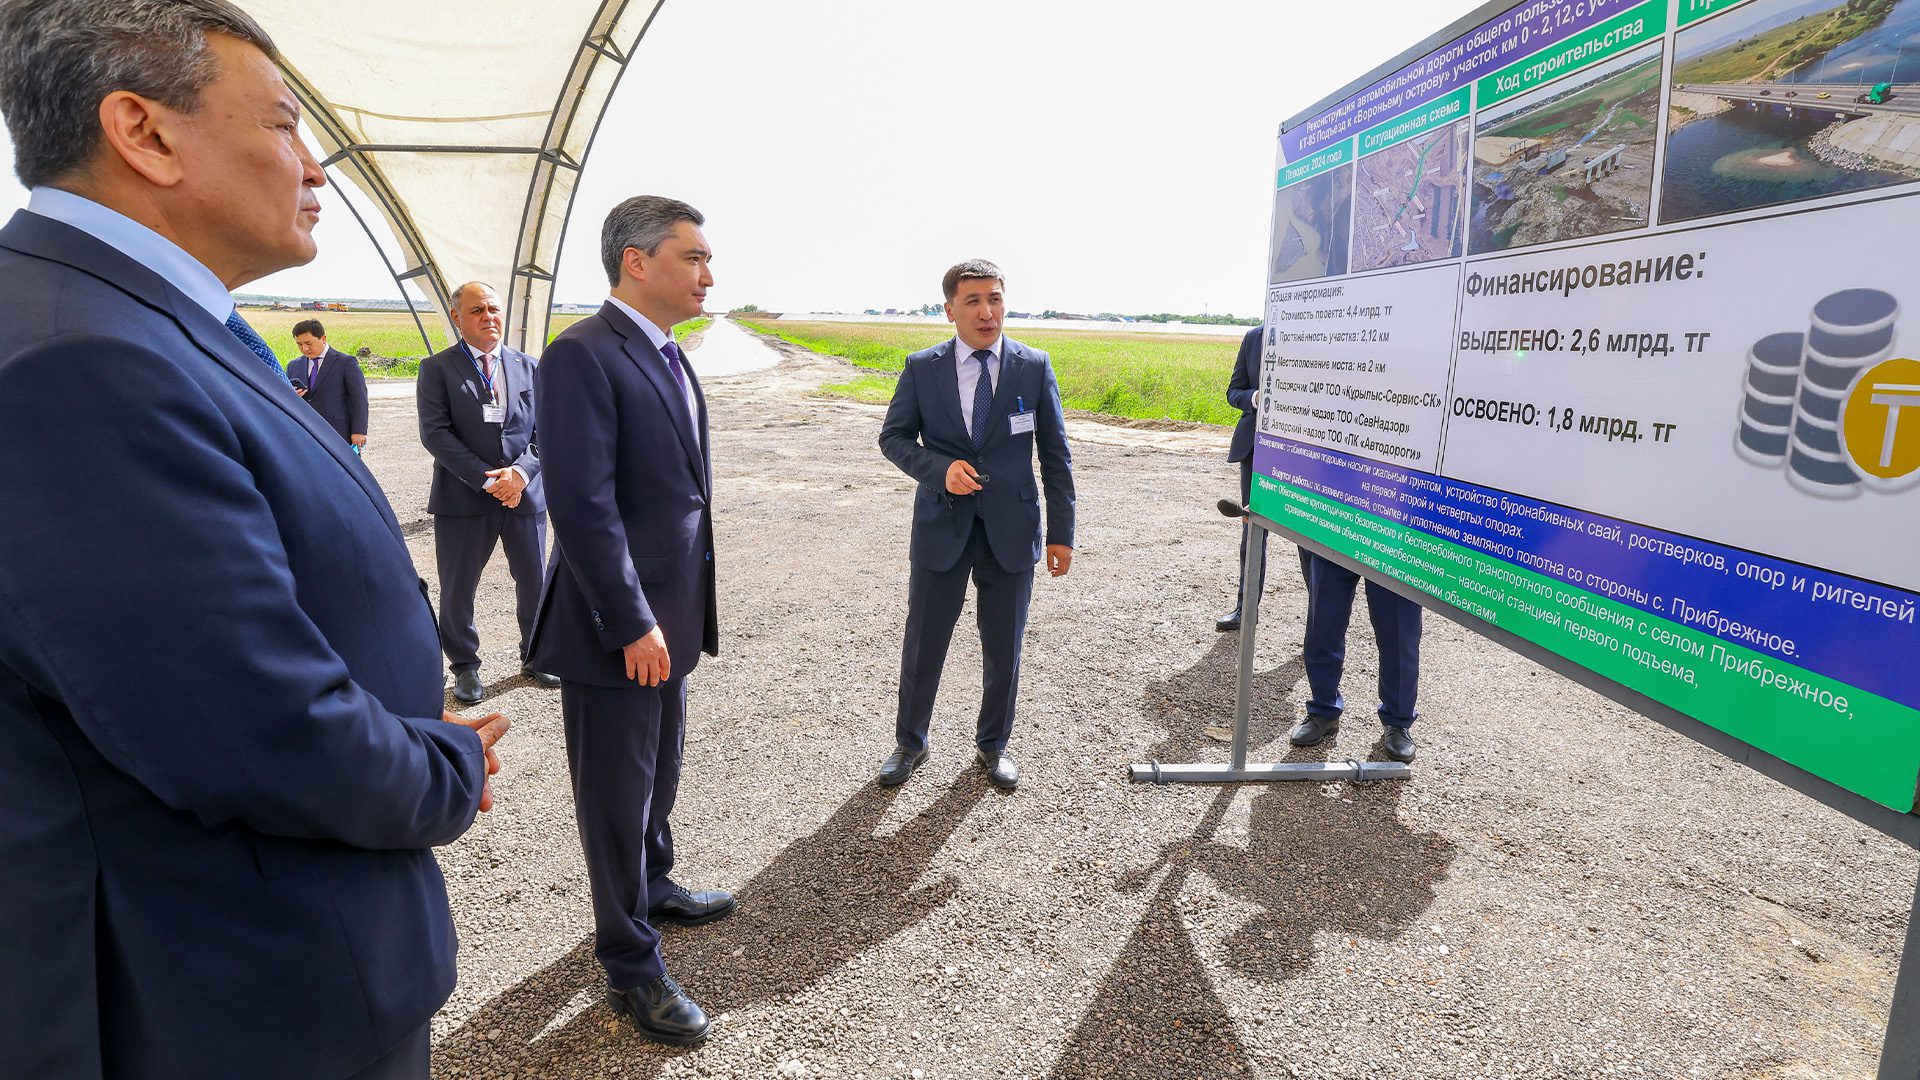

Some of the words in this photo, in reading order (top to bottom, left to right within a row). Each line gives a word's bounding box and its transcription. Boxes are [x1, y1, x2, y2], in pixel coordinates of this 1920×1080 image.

[1306, 101, 1356, 133] Реконструкция
[1357, 66, 1424, 108] автомобильной
[1426, 42, 1463, 74] дороги
[1467, 18, 1511, 51] общего
[1495, 75, 1520, 95] Ход
[1524, 18, 1643, 82] строительства
[1317, 121, 1346, 144] Подъезд
[1354, 94, 1403, 125] «Вороньему
[1405, 72, 1450, 100] острову»
[1453, 46, 1498, 81] участок
[1501, 36, 1517, 55] км
[1521, 27, 1529, 44] 0
[1364, 114, 1427, 149] Ситуационная
[1429, 99, 1460, 122] схема
[1311, 156, 1326, 170] 2024
[1327, 149, 1342, 166] года
[1270, 290, 1292, 304] Общая
[1293, 285, 1345, 304] информация:
[1466, 252, 1706, 297] Финансирование:
[1281, 308, 1314, 321] Стоимость
[1315, 308, 1345, 320] проекта:
[1346, 305, 1358, 319] 4,4
[1359, 306, 1381, 320] млрд.
[1384, 304, 1392, 316] тг
[1329, 331, 1359, 344] участка:
[1361, 329, 1377, 344] 2,12
[1379, 331, 1389, 341] км
[1460, 329, 1565, 354] ВЫДЕЛЕНО:
[1570, 328, 1601, 356] 2,6
[1606, 333, 1675, 358] млрд.
[1685, 332, 1711, 353] тг
[1275, 379, 1308, 392] Подрядчик
[1309, 382, 1324, 396] СМР
[1326, 384, 1340, 396] ТОО
[1277, 356, 1330, 370] Местоположение
[1331, 360, 1355, 371] моста:
[1357, 361, 1366, 371] на
[1367, 360, 1373, 372] 2
[1374, 362, 1385, 373] км
[1274, 400, 1310, 417] Технический
[1311, 407, 1335, 422] надзор
[1337, 410, 1353, 424] ТОО
[1354, 413, 1410, 434] «СевНадзор»
[1453, 397, 1541, 427] ОСВОЕНО:
[1547, 407, 1574, 432] 1,8
[1579, 414, 1643, 443] млрд.
[1653, 422, 1677, 443] тг
[1271, 421, 1302, 434] Авторский
[1303, 427, 1326, 440] надзор
[1328, 430, 1342, 444] ТОО
[1344, 433, 1359, 448] «ПК
[1360, 438, 1421, 461] «Автодороги»
[1361, 481, 1370, 492] на
[1371, 484, 1398, 501] первой,
[1400, 492, 1427, 509] второй
[1436, 503, 1483, 526] четвертых
[1485, 518, 1524, 539] опорах.
[1292, 475, 1313, 489] работы:
[1314, 482, 1320, 492] по
[1345, 492, 1371, 510] ригелей,
[1409, 515, 1460, 540] уплотнению
[1462, 532, 1514, 559] земляного
[1516, 549, 1564, 577] полотна
[1567, 567, 1583, 582] со
[1586, 573, 1648, 605] стороны
[1652, 596, 1665, 612] с.
[1671, 597, 1800, 659] Прибрежное.
[1372, 466, 1408, 483] скальным
[1409, 476, 1443, 496] грунтом,
[1445, 485, 1498, 508] устройство
[1500, 496, 1584, 533] буронабивных
[1587, 522, 1625, 546] свай,
[1628, 533, 1729, 576] ростверков,
[1736, 562, 1785, 590] опор
[1791, 575, 1806, 593] и
[1811, 581, 1915, 624] ригелей
[1341, 526, 1372, 548] объектом
[1372, 541, 1445, 578] жизнеобеспечения
[1459, 575, 1505, 604] насосной
[1507, 594, 1561, 627] станцией
[1564, 619, 1619, 651] первого
[1622, 643, 1698, 689] подъема,
[1360, 552, 1380, 569] также
[1381, 561, 1443, 597] туристическими
[1444, 590, 1498, 623] объектами.
[1354, 513, 1396, 539] безопасного
[1404, 531, 1473, 568] бесперебойного
[1475, 559, 1553, 598] транспортного
[1556, 591, 1634, 630] сообщения
[1638, 622, 1647, 635] с
[1651, 627, 1705, 658] селом
[1709, 643, 1853, 720] Прибрежное,
